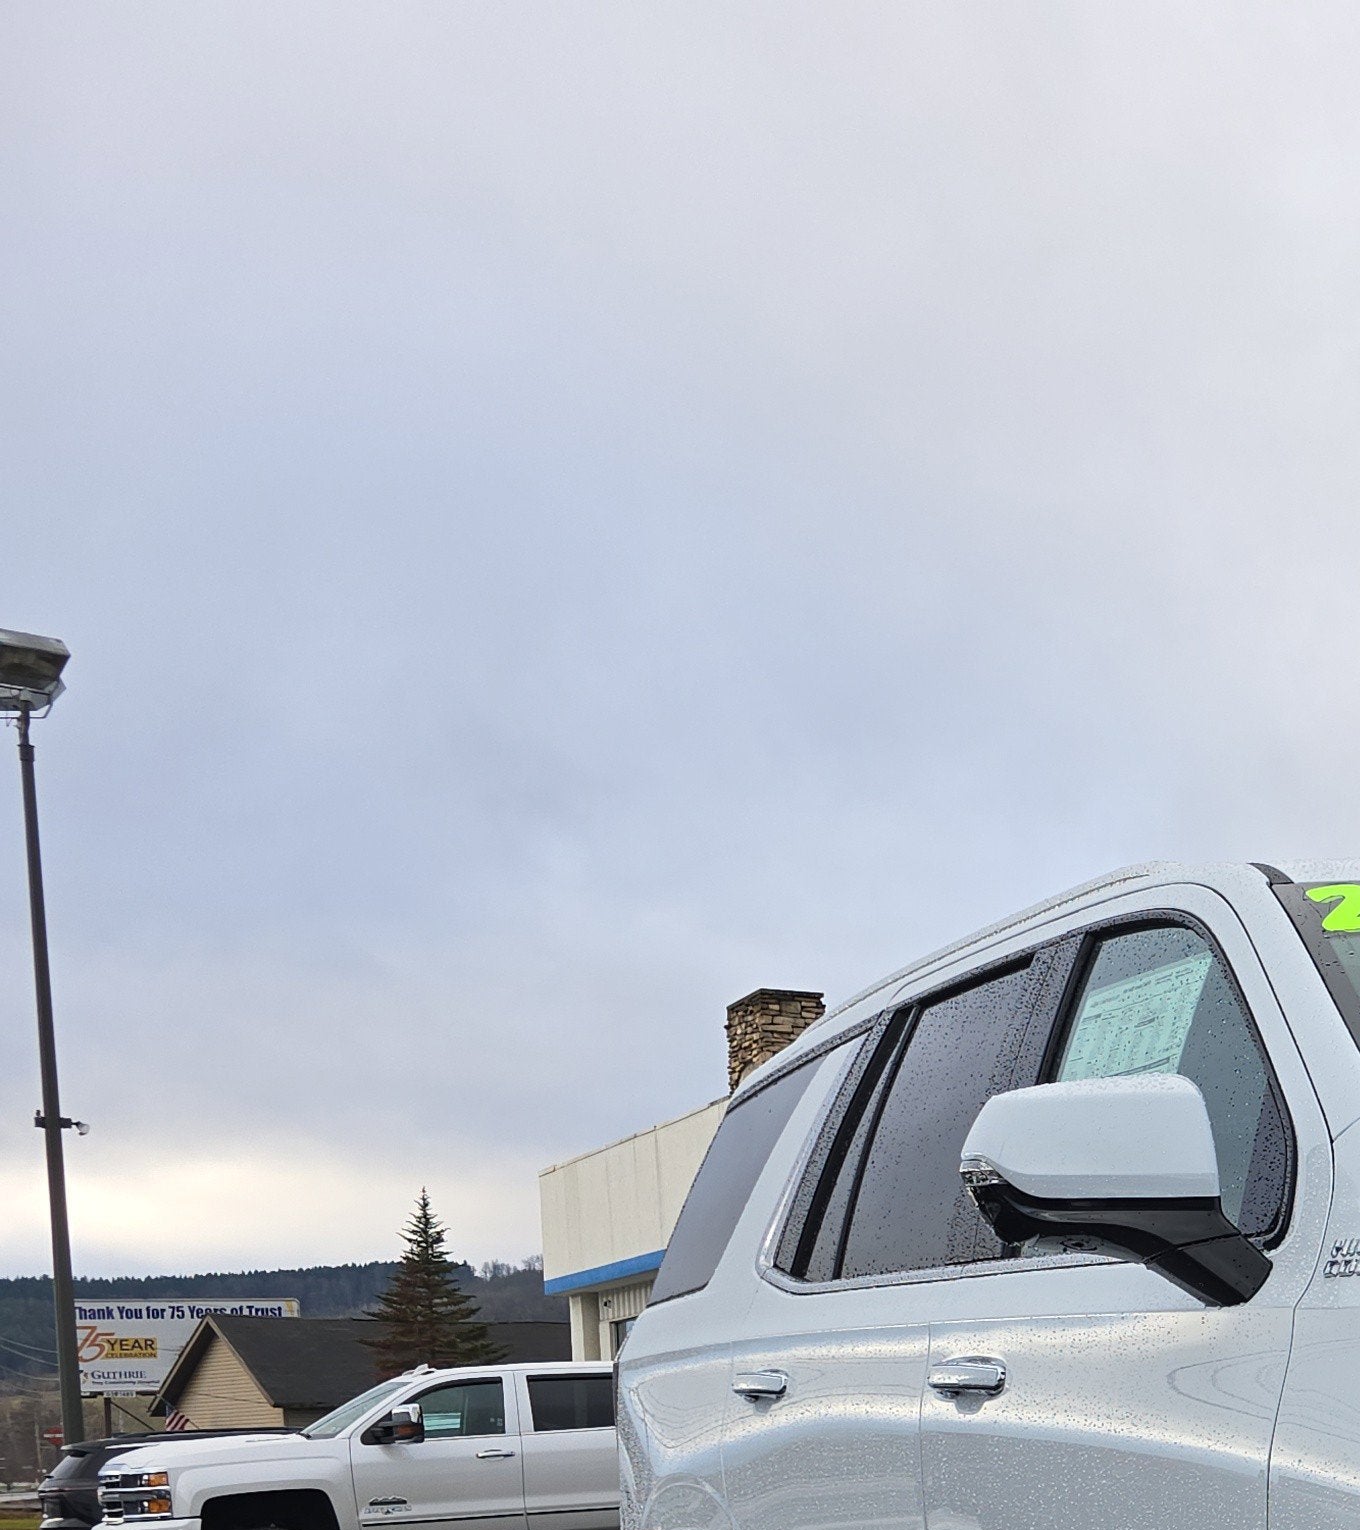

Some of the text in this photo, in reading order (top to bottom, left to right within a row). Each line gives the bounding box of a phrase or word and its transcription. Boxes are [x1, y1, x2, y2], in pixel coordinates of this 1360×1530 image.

[117, 1306, 142, 1320] You
[146, 1306, 165, 1320] for
[168, 1306, 185, 1320] 75
[230, 1306, 244, 1316] of
[246, 1306, 282, 1317] Trust
[77, 1325, 115, 1363] 75
[106, 1339, 155, 1351] YEAR
